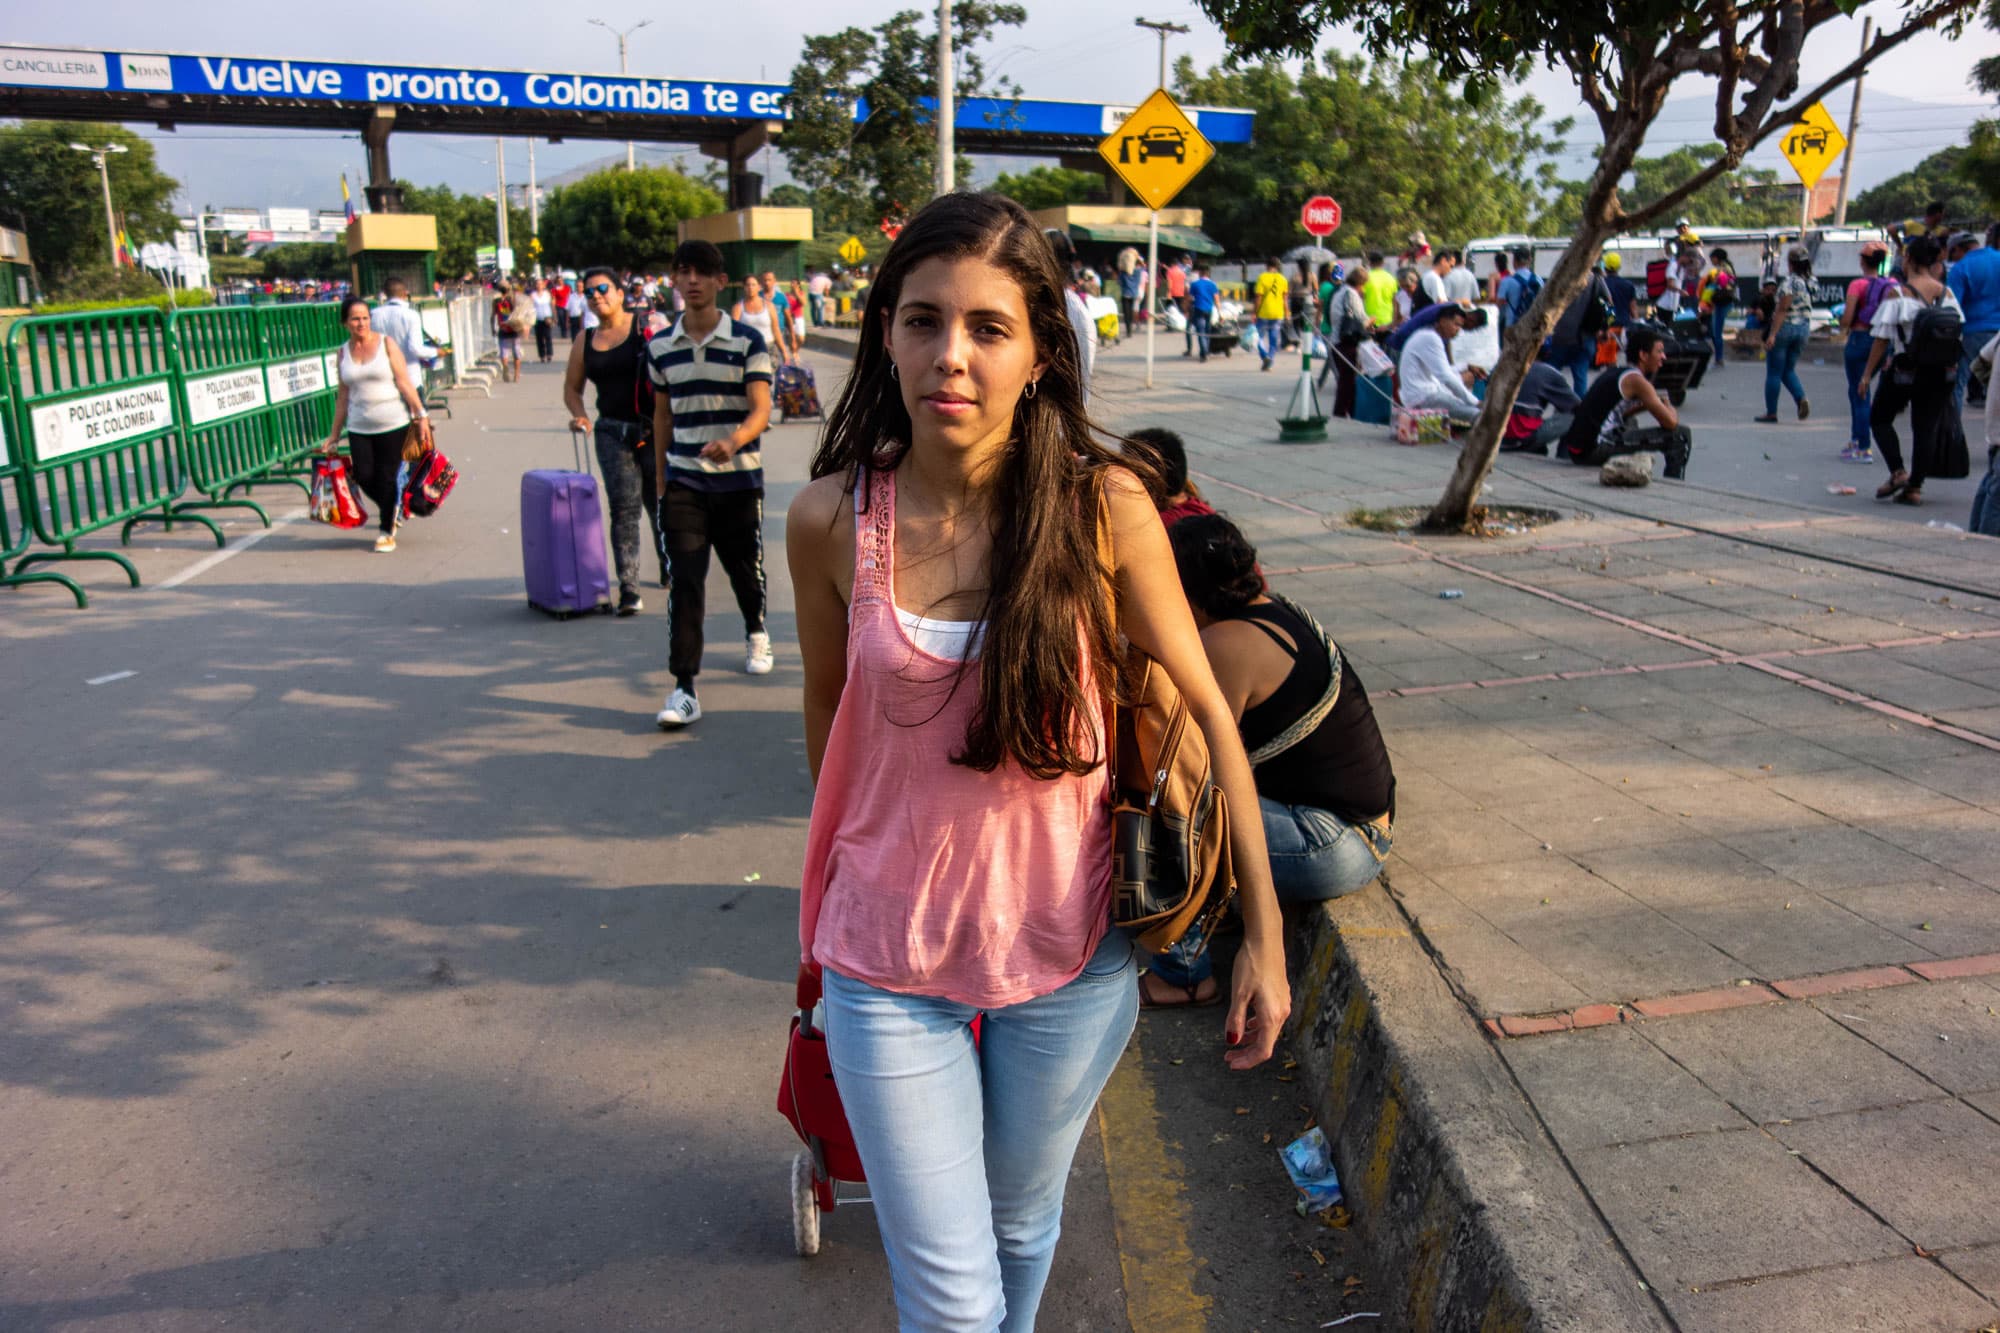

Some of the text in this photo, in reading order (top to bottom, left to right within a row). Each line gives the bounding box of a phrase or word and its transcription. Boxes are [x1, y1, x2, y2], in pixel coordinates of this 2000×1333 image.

[3, 59, 98, 75] CANCILLERIA
[136, 66, 170, 78] DIAN
[198, 57, 342, 95] Vuelve
[366, 71, 509, 106] pronto,
[525, 74, 689, 111] Colombia
[702, 84, 738, 112] te
[1308, 207, 1336, 225] PARE
[206, 374, 260, 395] POLICIA NACIONAL
[69, 389, 164, 422] POLICIA NACIONAL
[217, 391, 256, 410] DE COLOMBIA
[86, 411, 155, 439] DE COLOMBIA
